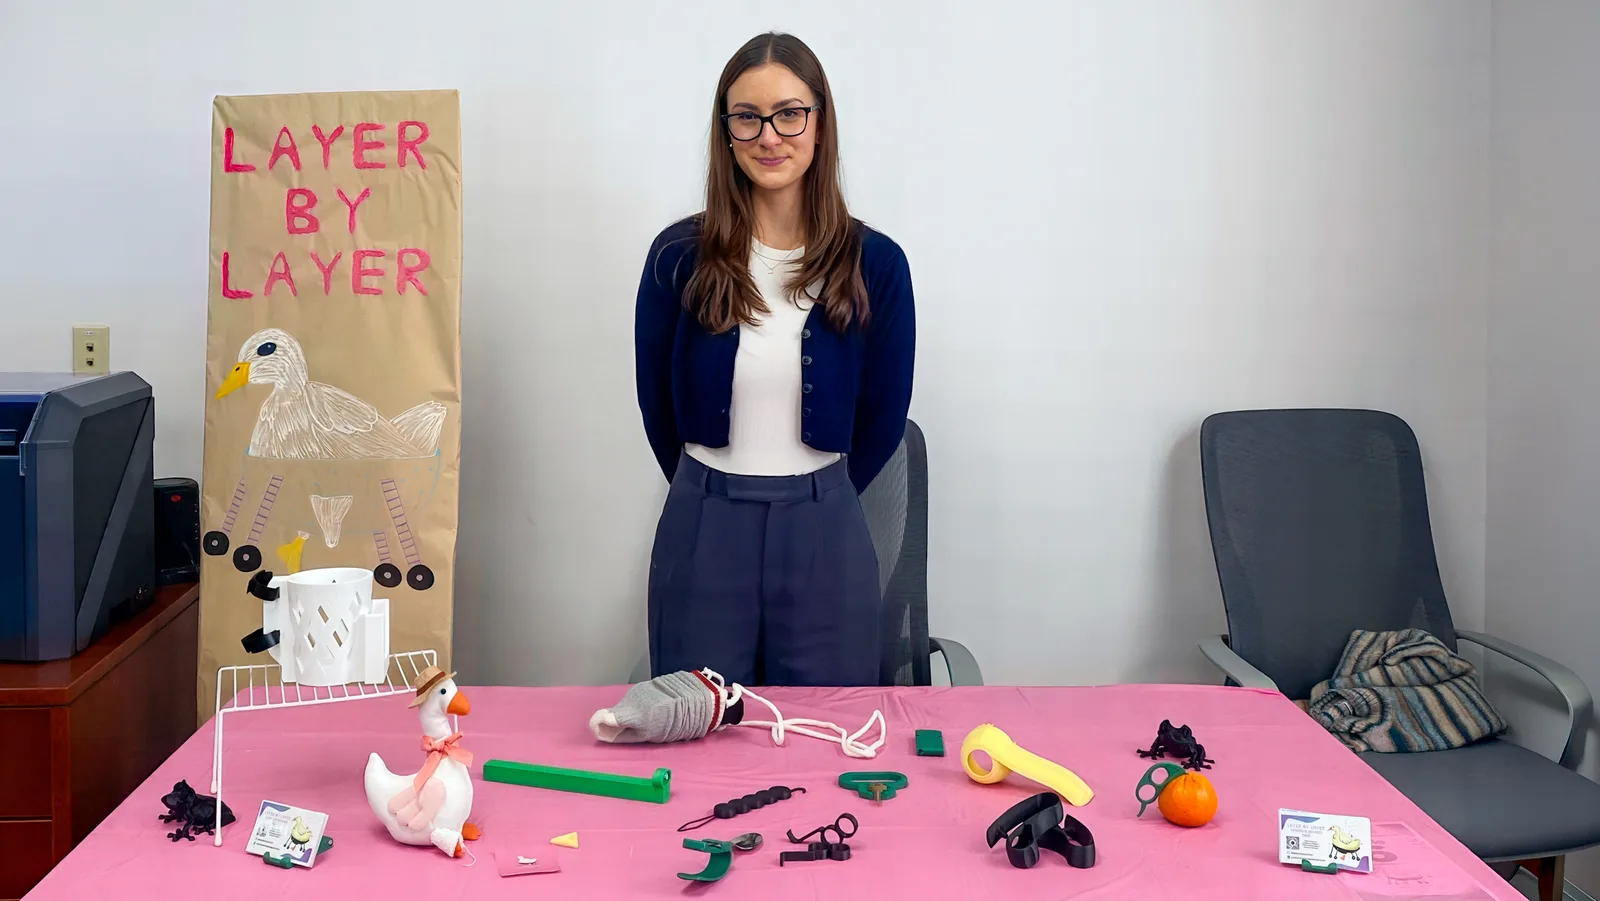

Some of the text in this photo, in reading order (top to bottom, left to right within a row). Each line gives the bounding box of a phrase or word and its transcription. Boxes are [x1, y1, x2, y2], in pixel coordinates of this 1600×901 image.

[224, 120, 430, 173] LAYER
[286, 187, 371, 235] BY
[222, 248, 431, 299] LAYER
